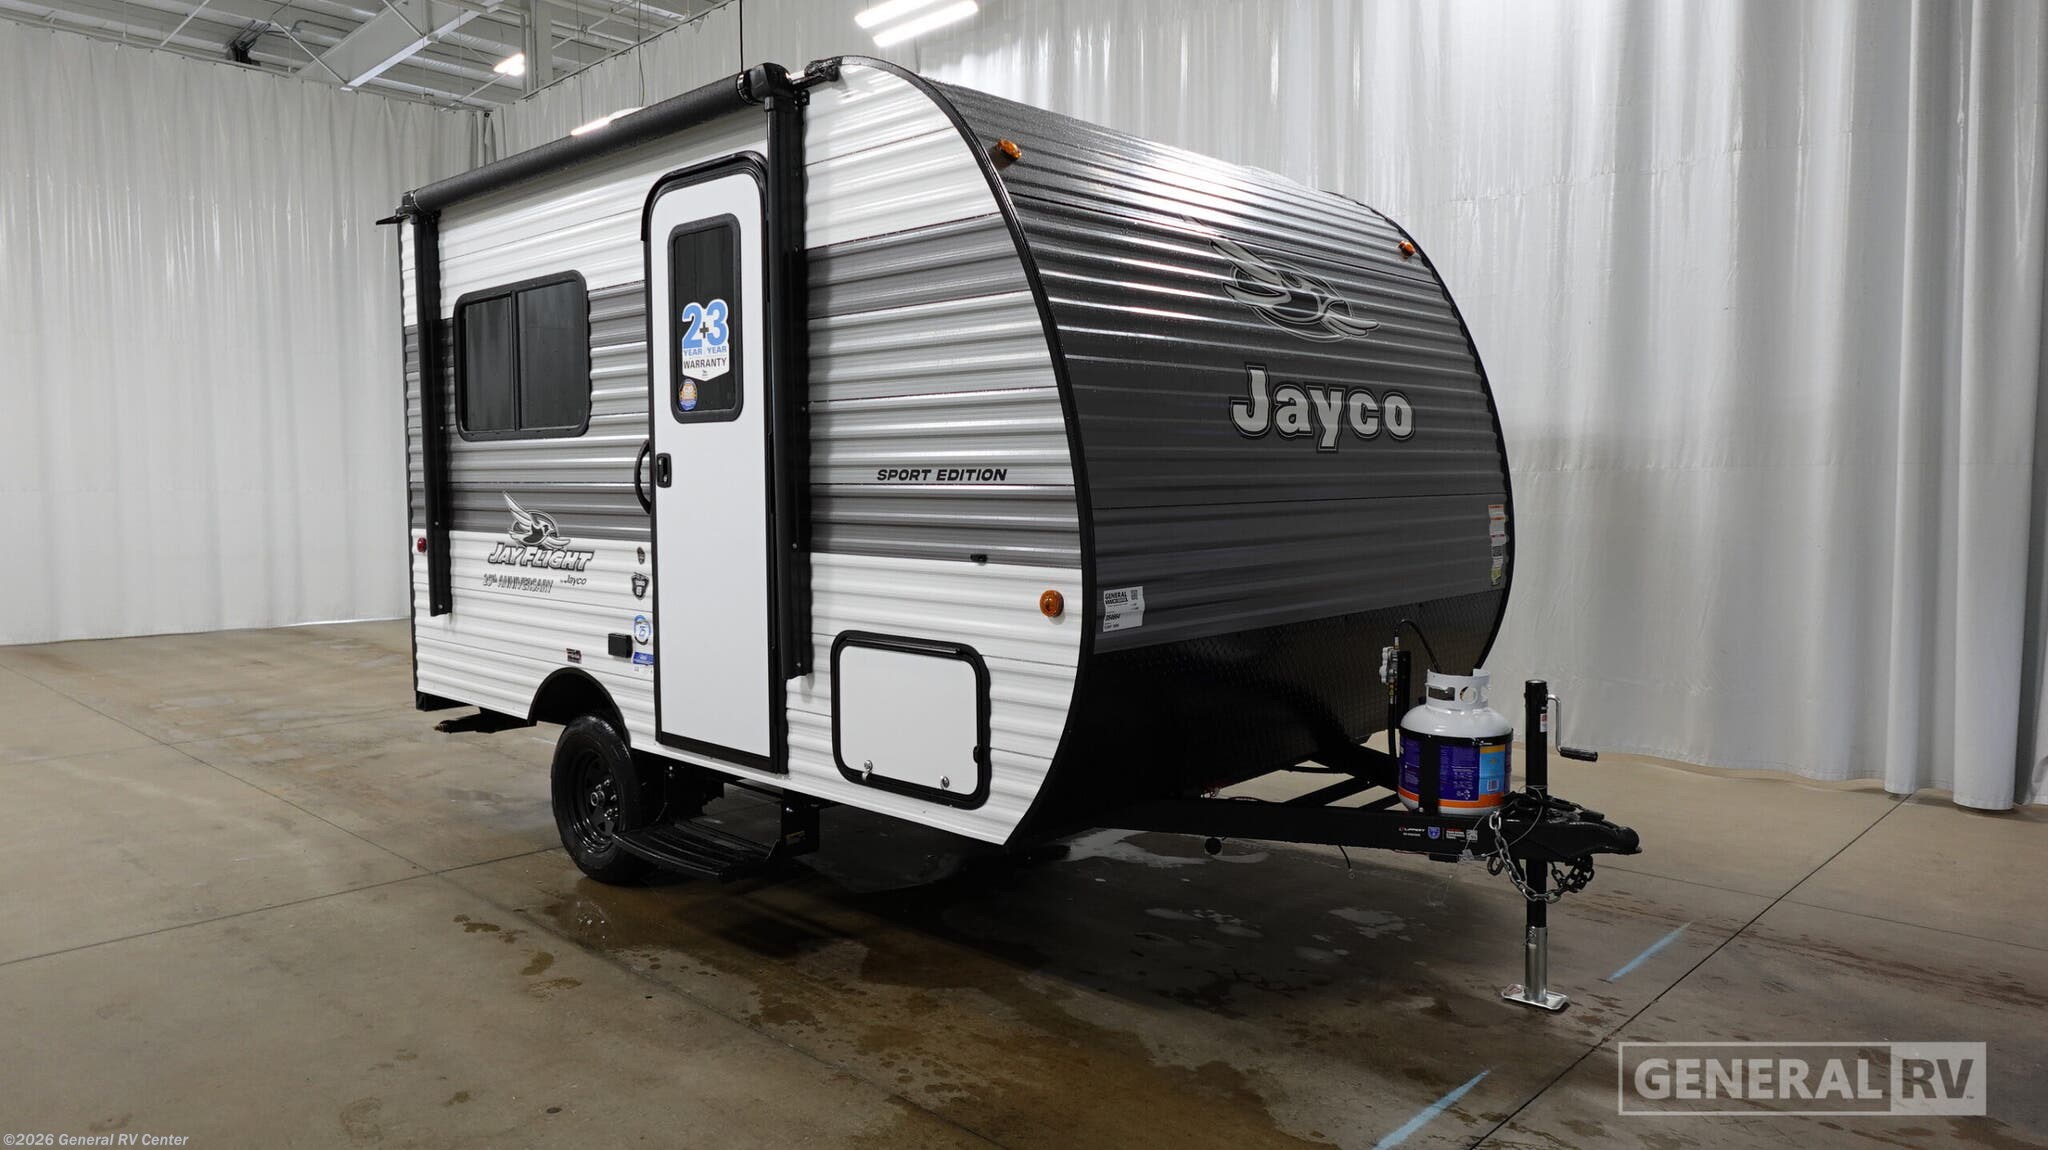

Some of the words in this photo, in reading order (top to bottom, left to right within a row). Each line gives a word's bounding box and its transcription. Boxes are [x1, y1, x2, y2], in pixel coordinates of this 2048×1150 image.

[683, 348, 703, 357] YEAR
[707, 345, 727, 354] YEAR
[683, 357, 727, 369] WARRANTY
[1230, 364, 1416, 453] Jayco
[877, 468, 932, 482] SPORT
[935, 468, 1008, 482] EDITION
[488, 542, 524, 566] JAY
[520, 545, 594, 571] FLIGHT
[567, 574, 588, 587] Jayco
